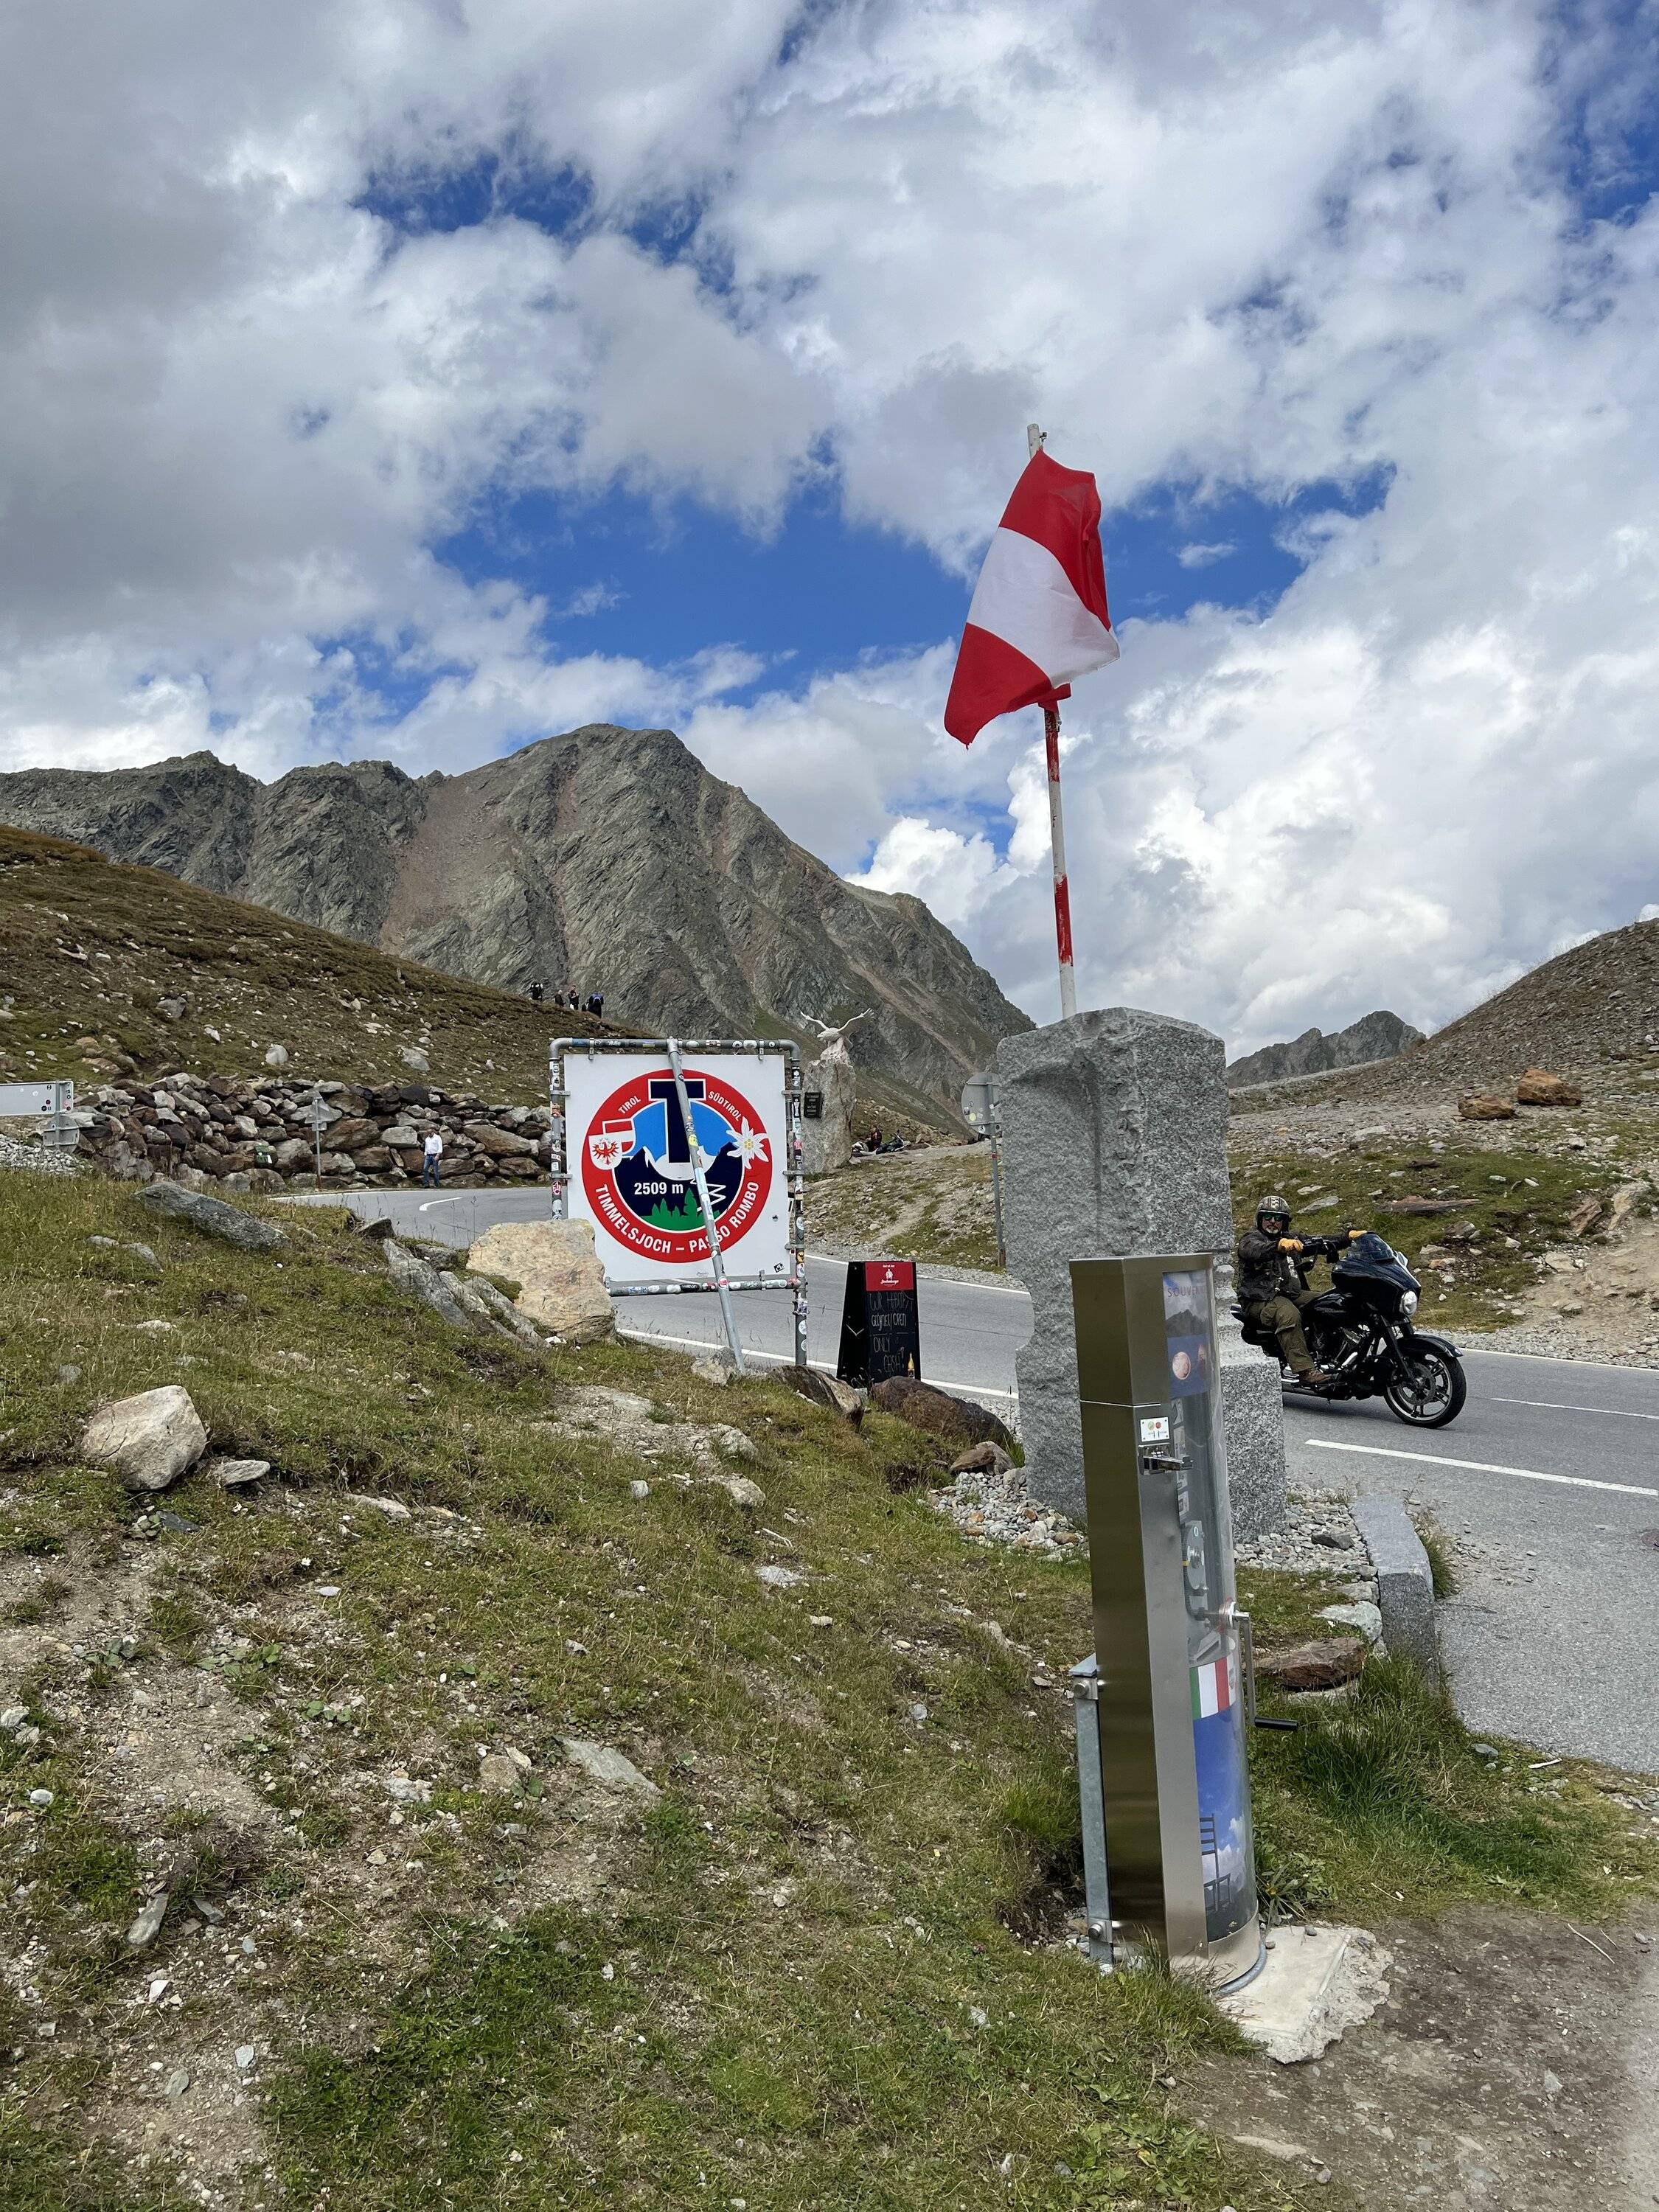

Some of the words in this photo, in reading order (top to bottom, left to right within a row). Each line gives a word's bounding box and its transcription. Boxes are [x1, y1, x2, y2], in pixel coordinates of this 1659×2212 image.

[618, 1095, 641, 1114] TIROL
[708, 1091, 742, 1121] SÜDTIROL
[634, 1182, 667, 1195] 2509
[672, 1183, 684, 1194] m
[596, 1183, 672, 1253] TIMMELSJOCH
[728, 1182, 759, 1228] ROMBO
[873, 1336, 890, 1353] ONLY
